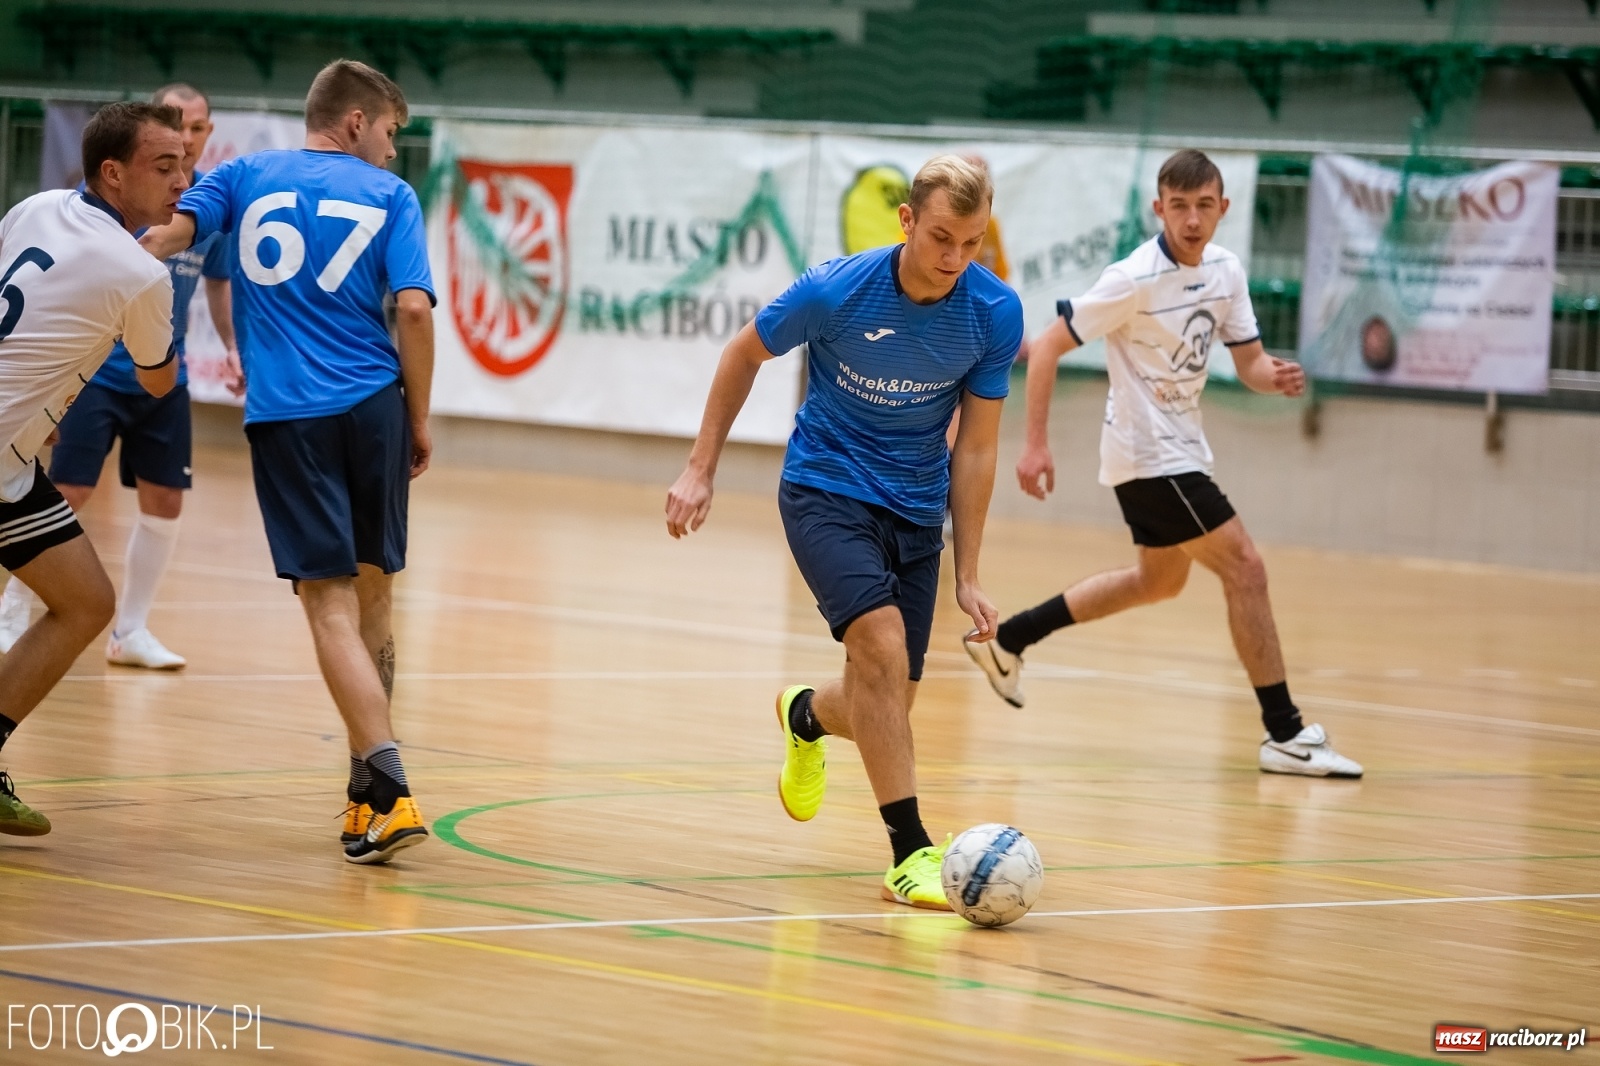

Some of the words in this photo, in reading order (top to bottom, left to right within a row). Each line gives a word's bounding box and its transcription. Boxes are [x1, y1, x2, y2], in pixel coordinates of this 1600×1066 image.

[239, 191, 388, 293] 67
[607, 212, 768, 273] MIASTO
[836, 375, 906, 407] Metallbau
